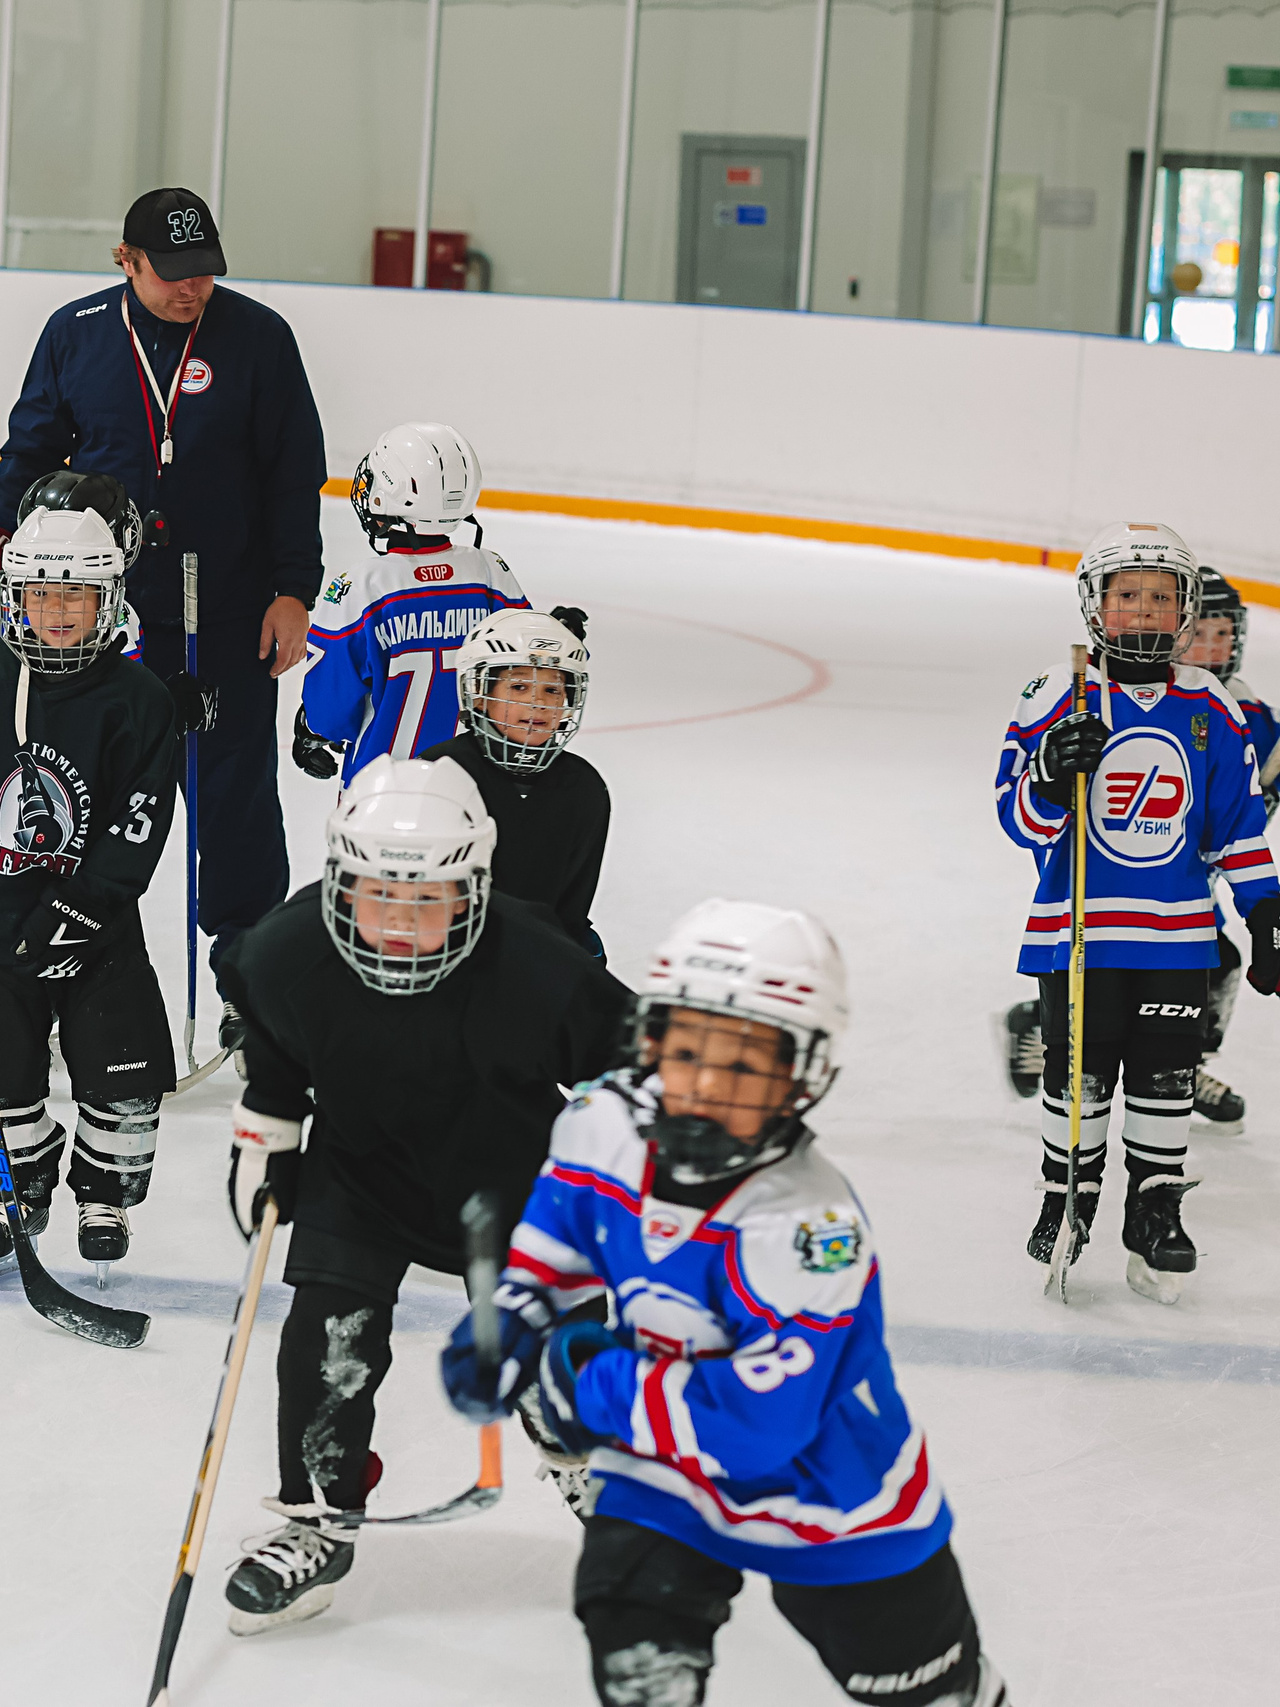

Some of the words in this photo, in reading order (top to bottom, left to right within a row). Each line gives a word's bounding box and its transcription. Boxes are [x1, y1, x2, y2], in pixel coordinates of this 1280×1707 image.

[167, 208, 205, 244] 32
[75, 303, 108, 317] CCM
[381, 470, 394, 486] CCM
[1130, 543, 1169, 551] BAUER
[33, 553, 74, 561] BAUER
[420, 565, 448, 581] STOP
[31, 742, 92, 850] ТЮМЕНСКИЙ
[1133, 820, 1171, 836] УБИН
[379, 849, 426, 862] Reebok
[51, 899, 102, 931] NORDWAY
[1138, 1003, 1202, 1019] CCM
[106, 1061, 148, 1073] NORDWAY
